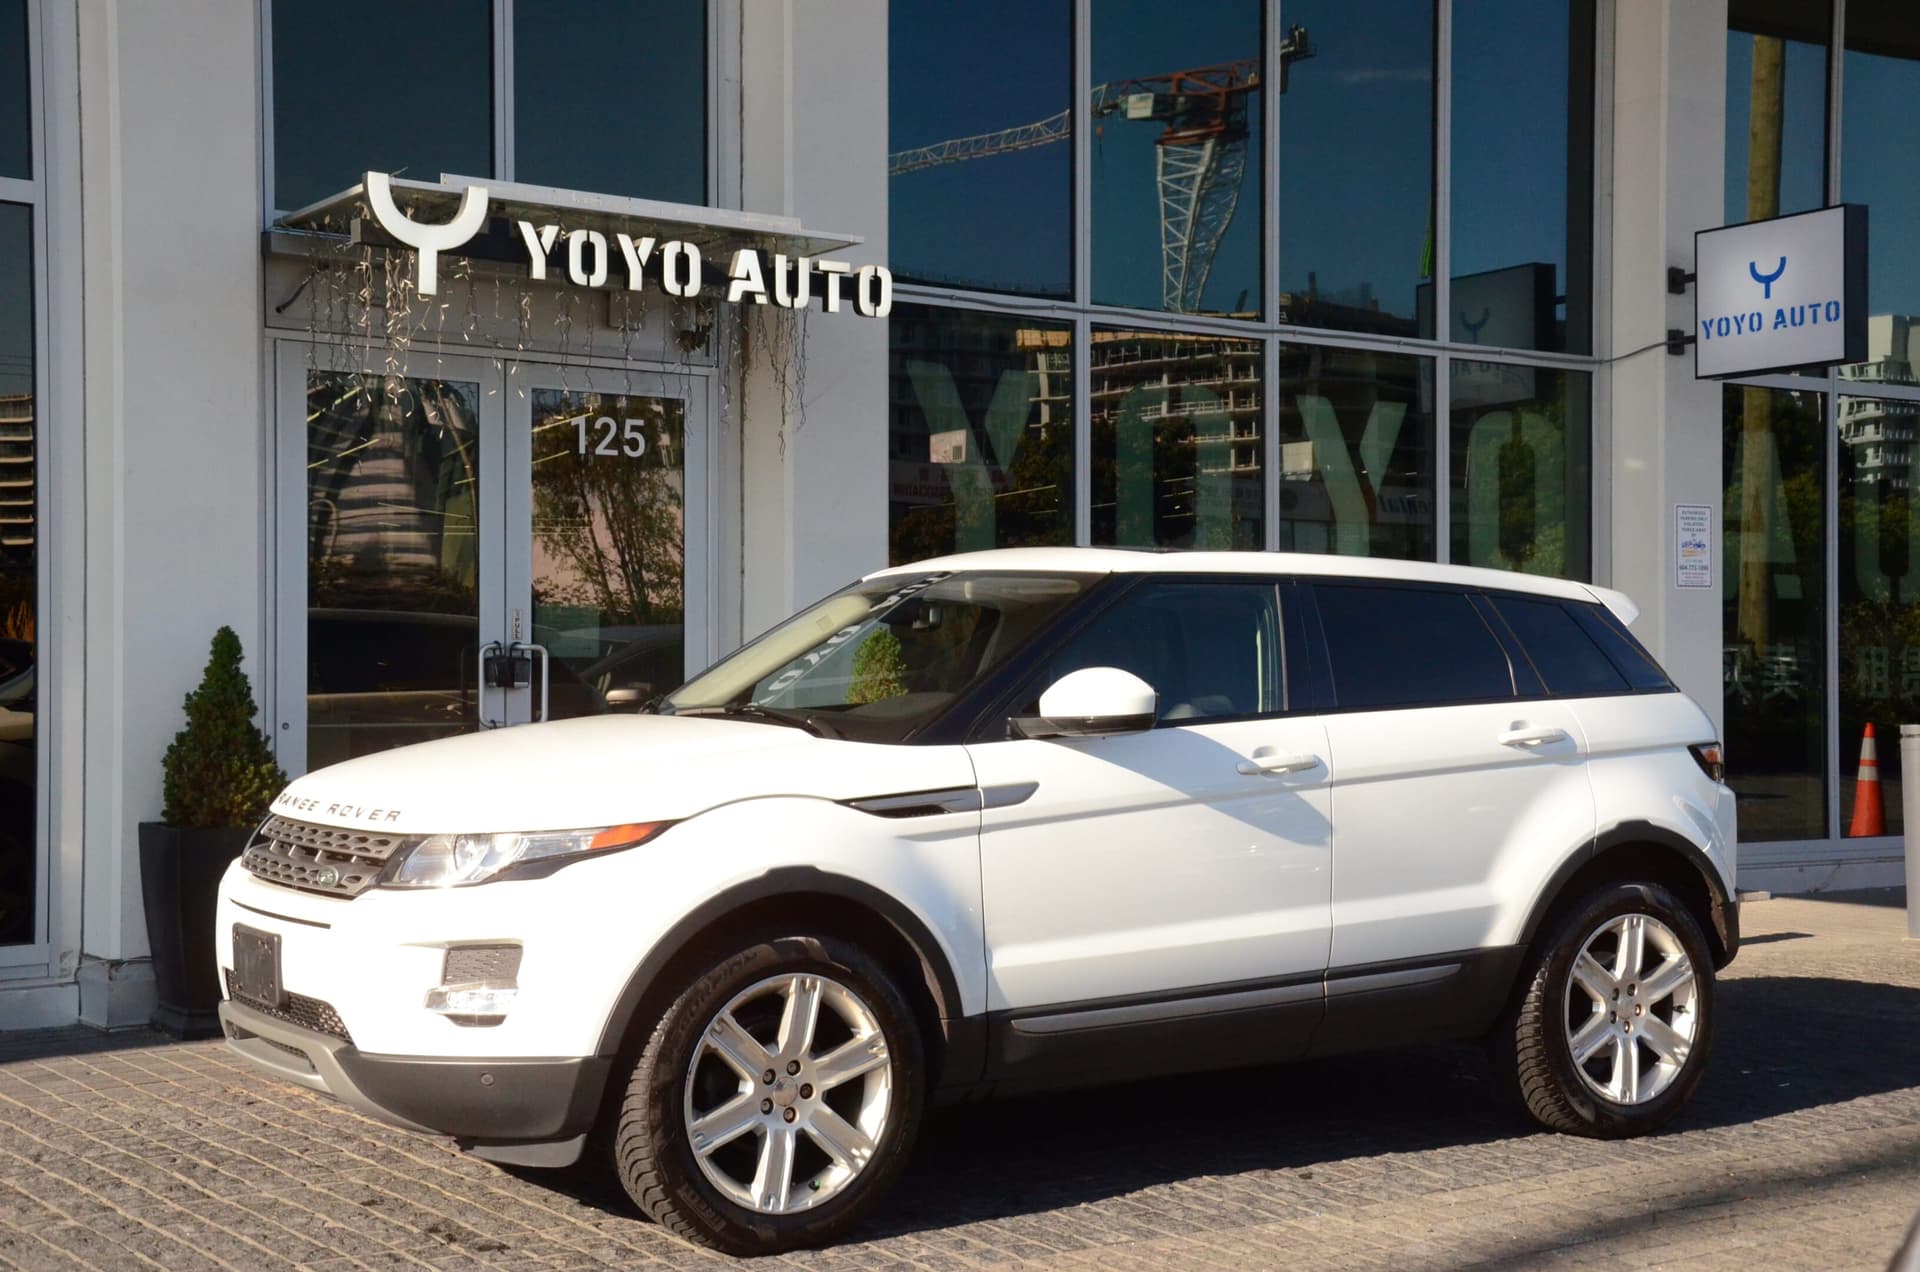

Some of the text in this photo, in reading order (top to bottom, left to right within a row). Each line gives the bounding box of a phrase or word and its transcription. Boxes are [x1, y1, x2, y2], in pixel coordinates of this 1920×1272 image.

[517, 220, 701, 298] YOYO
[727, 248, 893, 318] AUTO
[1701, 300, 1841, 340] YOYO AUTO
[570, 416, 646, 457] 125
[327, 803, 402, 822] ROVER
